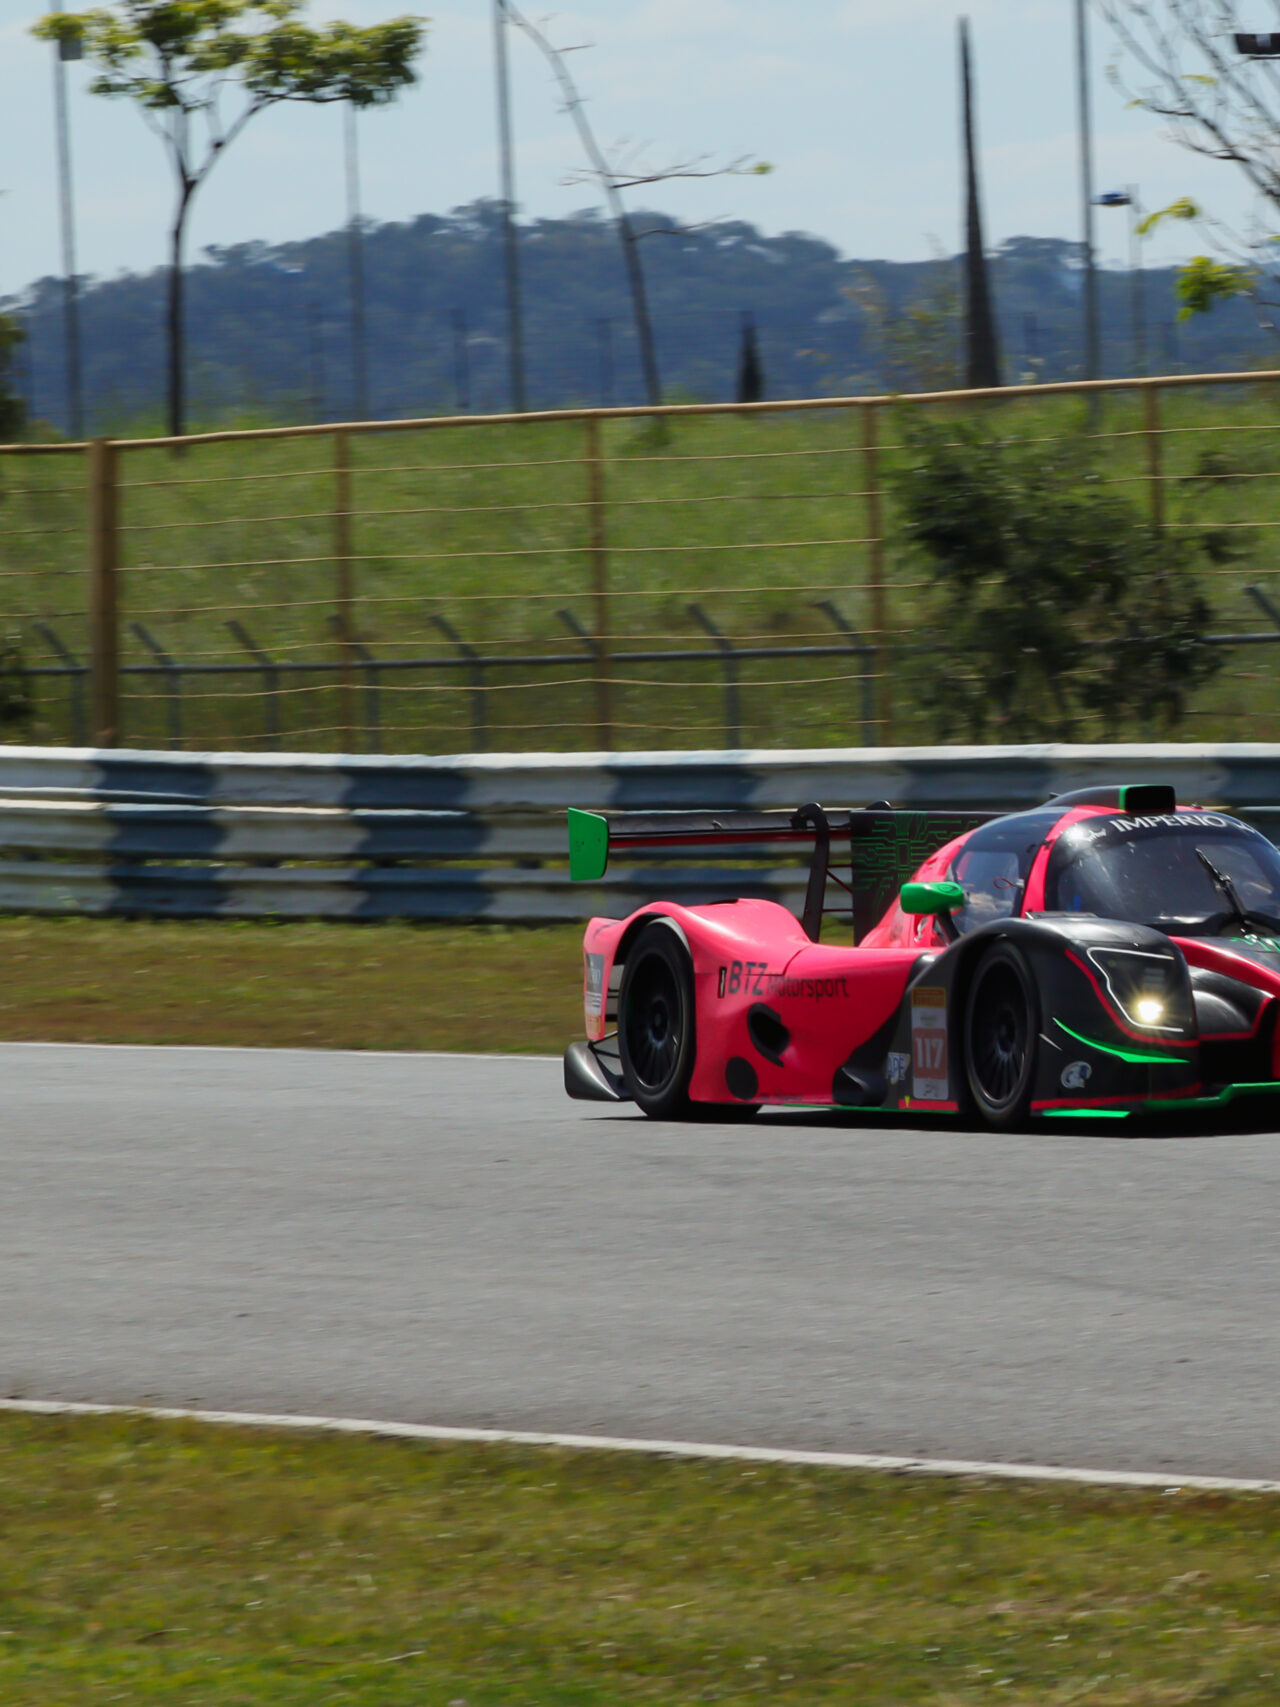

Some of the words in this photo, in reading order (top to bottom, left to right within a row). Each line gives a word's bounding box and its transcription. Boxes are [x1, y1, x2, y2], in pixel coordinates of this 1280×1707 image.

[728, 960, 768, 996] BTZ
[767, 973, 850, 1003] Motorsport
[916, 1037, 944, 1069] 117
